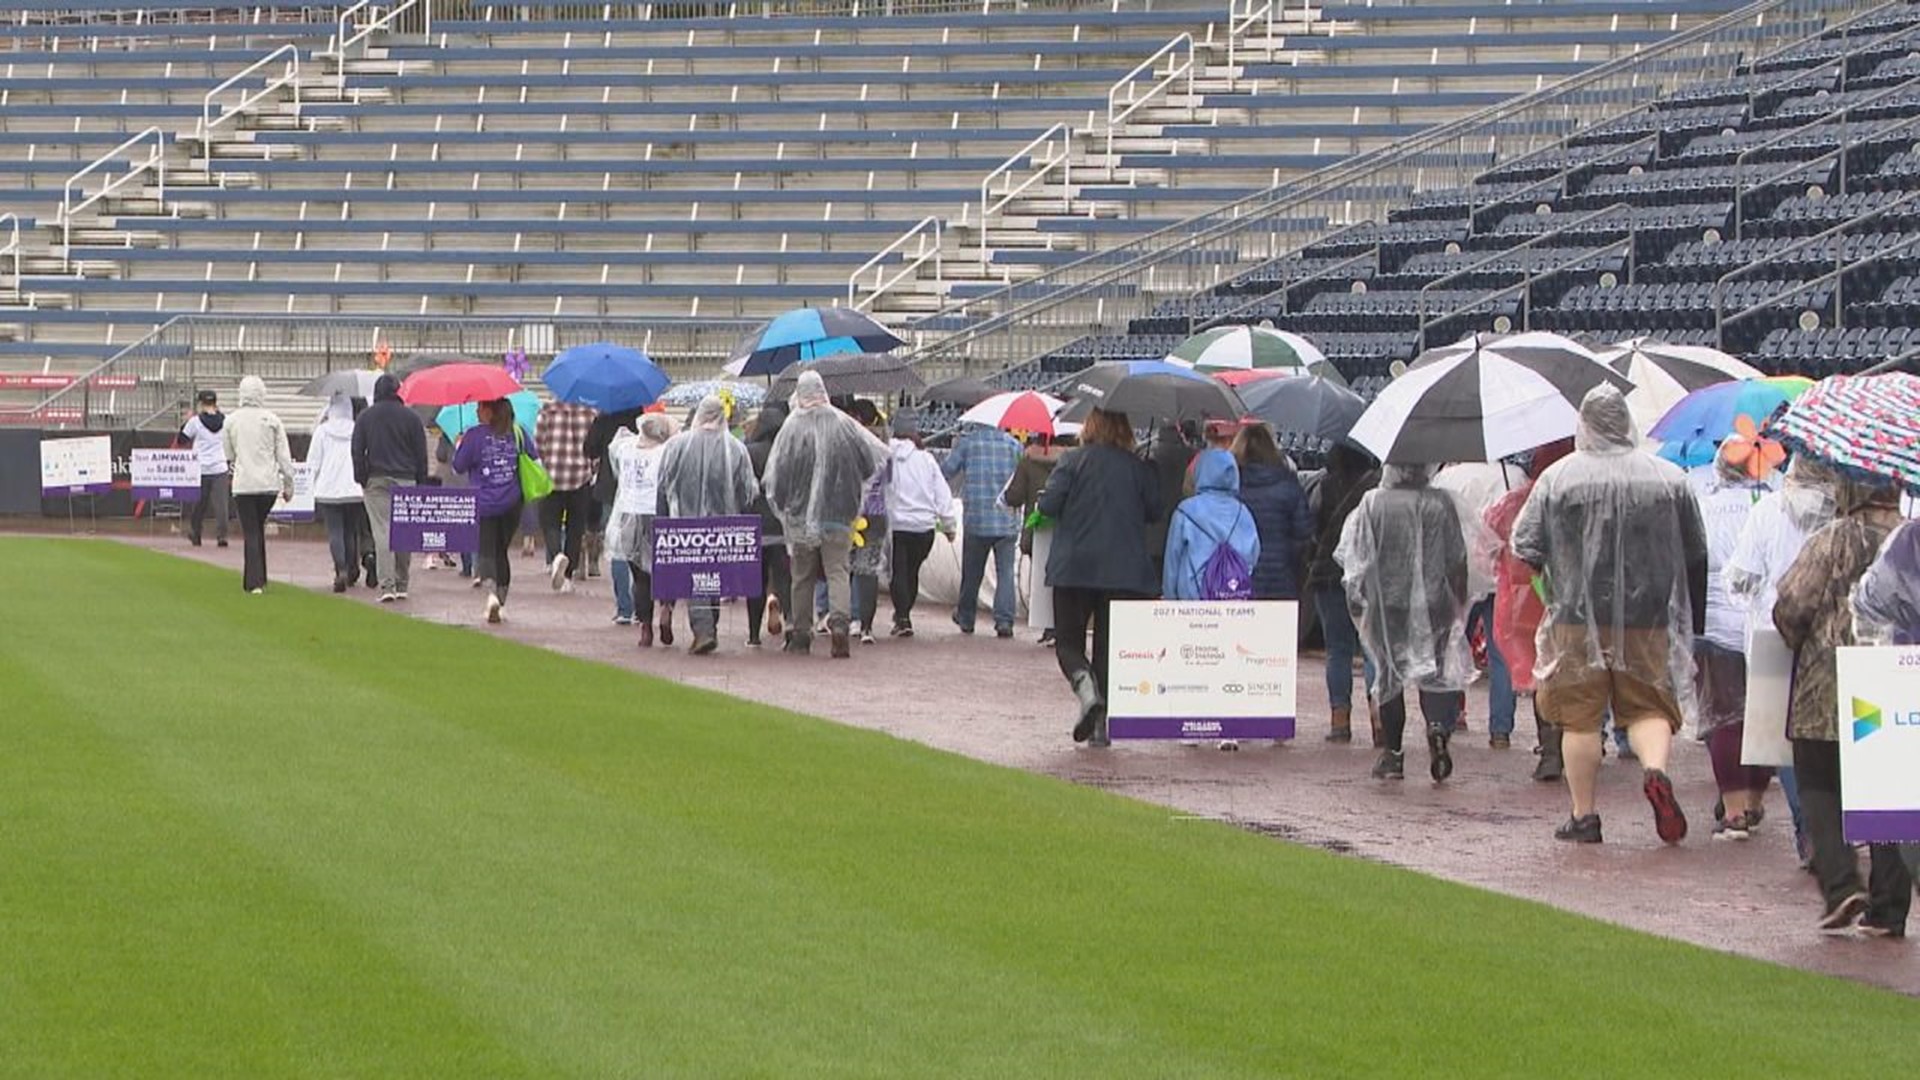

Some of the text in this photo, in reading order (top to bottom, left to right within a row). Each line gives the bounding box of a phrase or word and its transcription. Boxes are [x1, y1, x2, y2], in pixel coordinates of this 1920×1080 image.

[151, 453, 199, 462] AIMWALK
[393, 494, 476, 503] BLACK AMERICANS
[656, 532, 756, 548] ADVOCATES
[674, 548, 702, 556] THOSE
[692, 572, 721, 580] WALK
[1178, 607, 1222, 616] NATIONAL
[1226, 607, 1256, 616] TEAMS
[1118, 650, 1154, 660] Genesis
